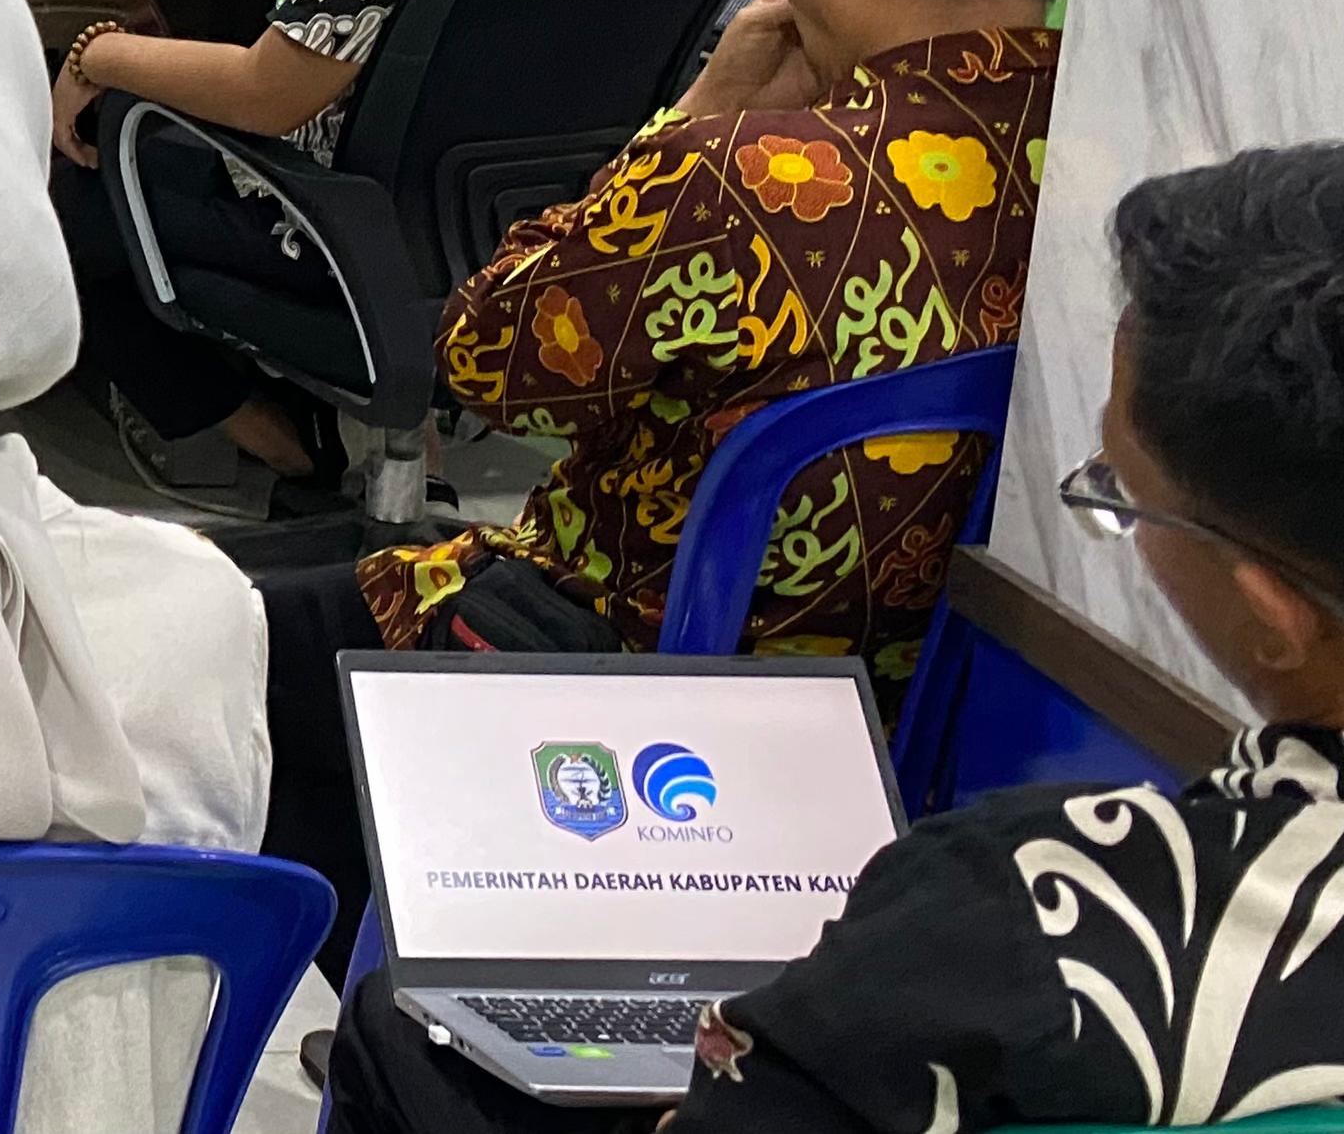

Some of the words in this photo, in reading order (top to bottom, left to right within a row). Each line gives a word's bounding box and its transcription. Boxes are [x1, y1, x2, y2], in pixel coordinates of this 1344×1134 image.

[637, 826, 733, 843] KOMINFO
[427, 871, 568, 890] PEMERINTAH
[575, 873, 663, 891] DAERAH
[669, 874, 803, 892] KABUPATEN
[808, 875, 859, 893] KAU
[649, 972, 690, 985] acer
